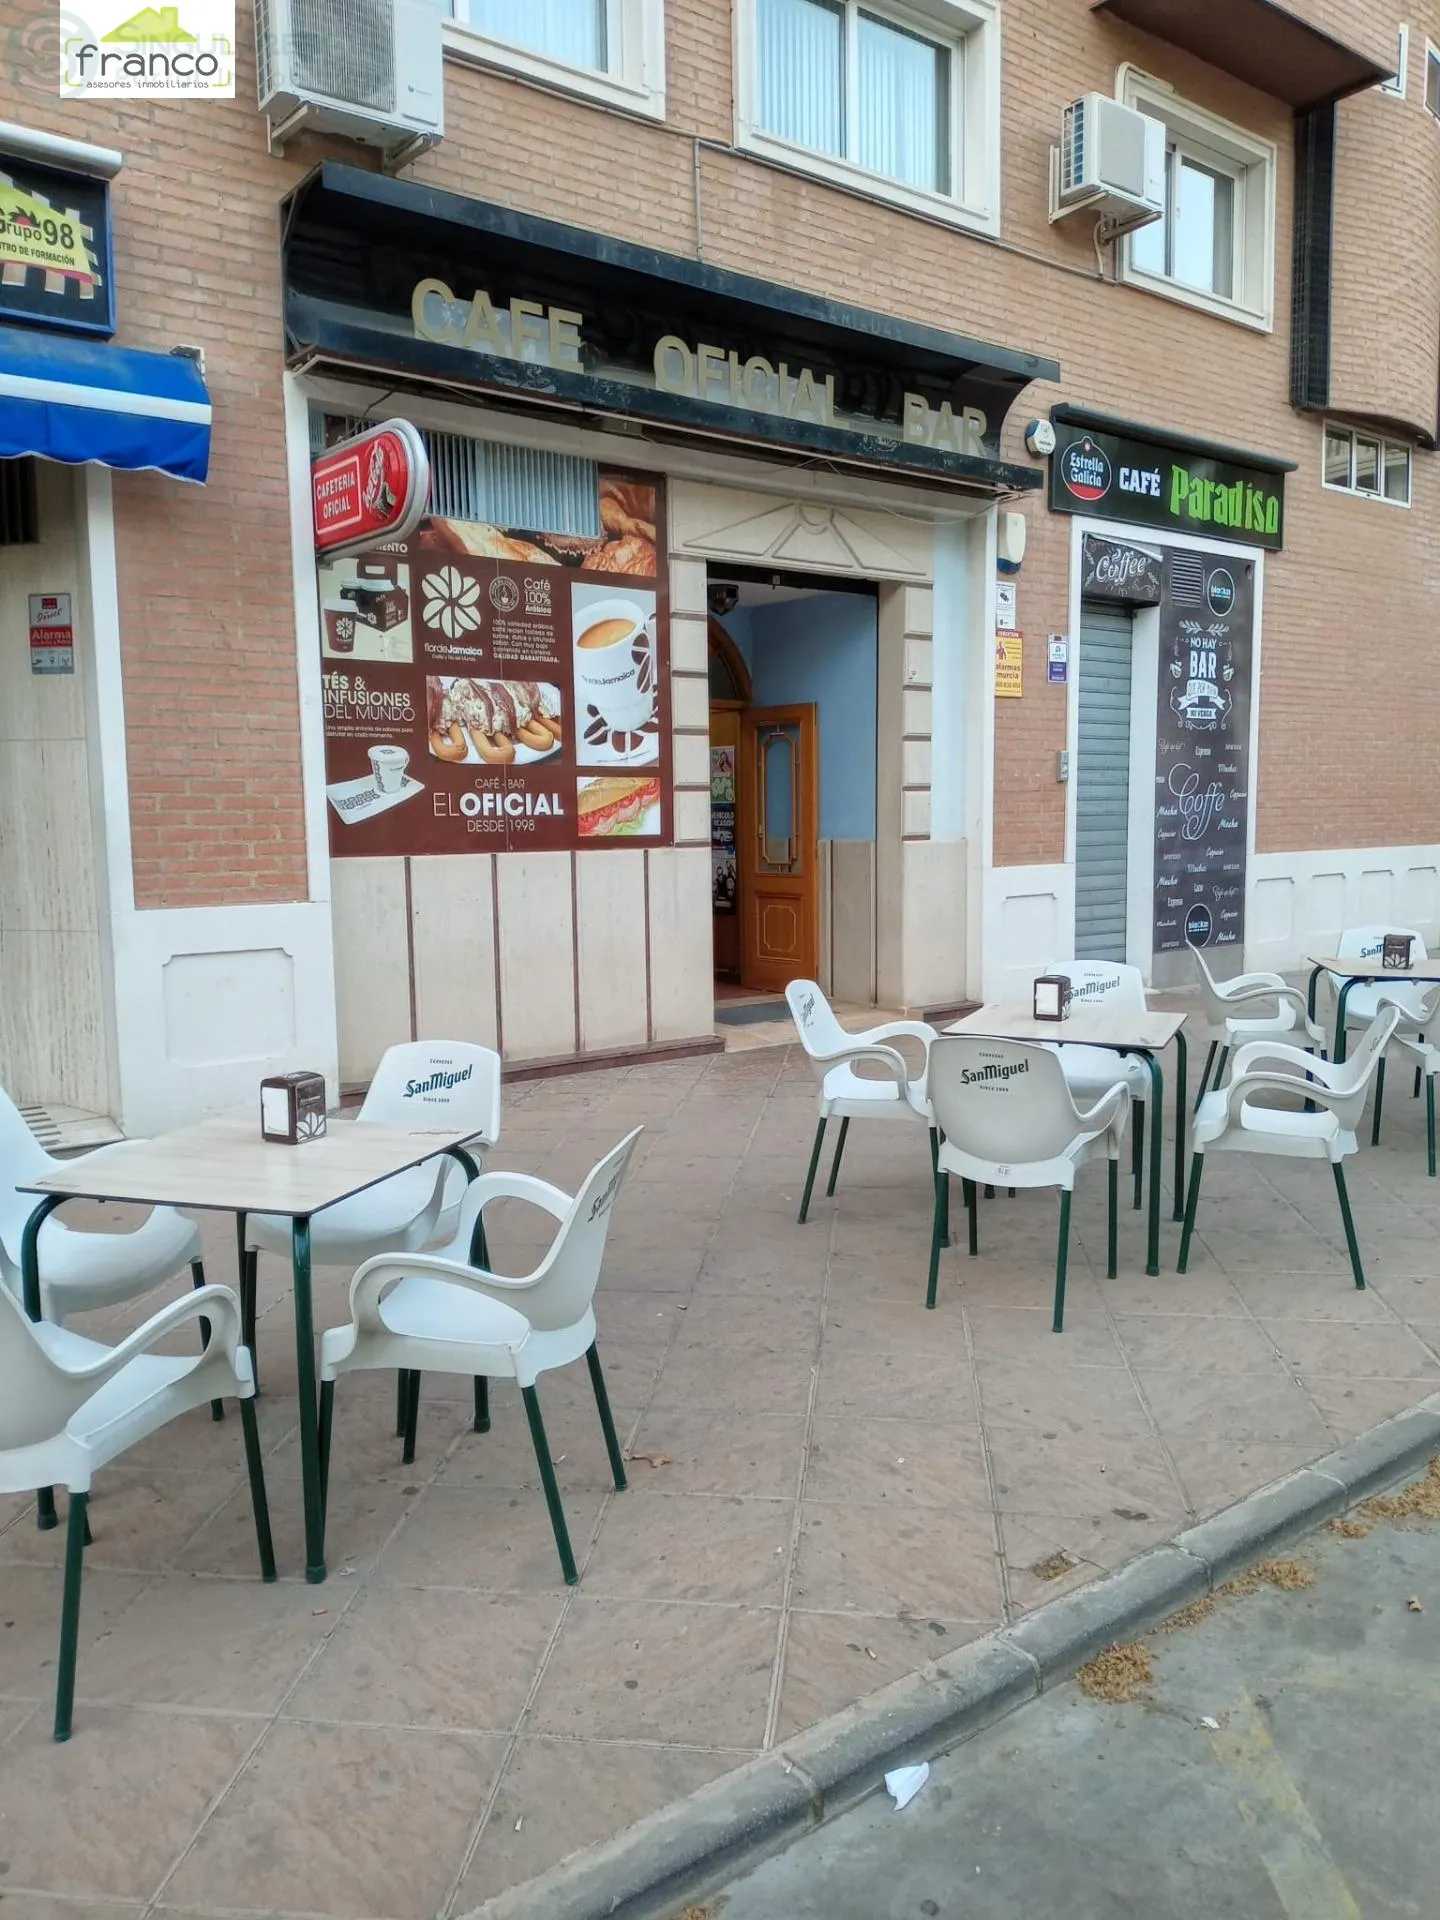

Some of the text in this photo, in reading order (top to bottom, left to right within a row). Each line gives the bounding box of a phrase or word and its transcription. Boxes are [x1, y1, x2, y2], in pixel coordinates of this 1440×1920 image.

[43, 219, 75, 250] 98
[0, 242, 75, 266] TRO DE FORMACIÓN
[411, 278, 988, 459] CAFE OFICIAL BAR
[1070, 452, 1103, 473] Estrella
[316, 471, 356, 500] CAFETERIA
[1071, 467, 1102, 487] Galicia
[323, 495, 351, 519] OFICIAL
[1119, 464, 1279, 534] CAFÉ Paradiso
[1096, 551, 1147, 585] Coffee
[523, 577, 551, 591] Café
[525, 591, 551, 605] 100%
[1190, 637, 1217, 649] NO HAY
[1190, 650, 1217, 679] BAR
[322, 671, 366, 690] TÉS &
[323, 690, 410, 706] INFUSIONES
[324, 704, 415, 721] DEL MUNDO
[475, 777, 525, 789] CAFÉ BAR
[460, 792, 564, 816] OFICIAL
[467, 819, 535, 833] DESDE 1998
[403, 1063, 473, 1098] SanMiguel
[960, 1058, 1029, 1085] SanMiguel
